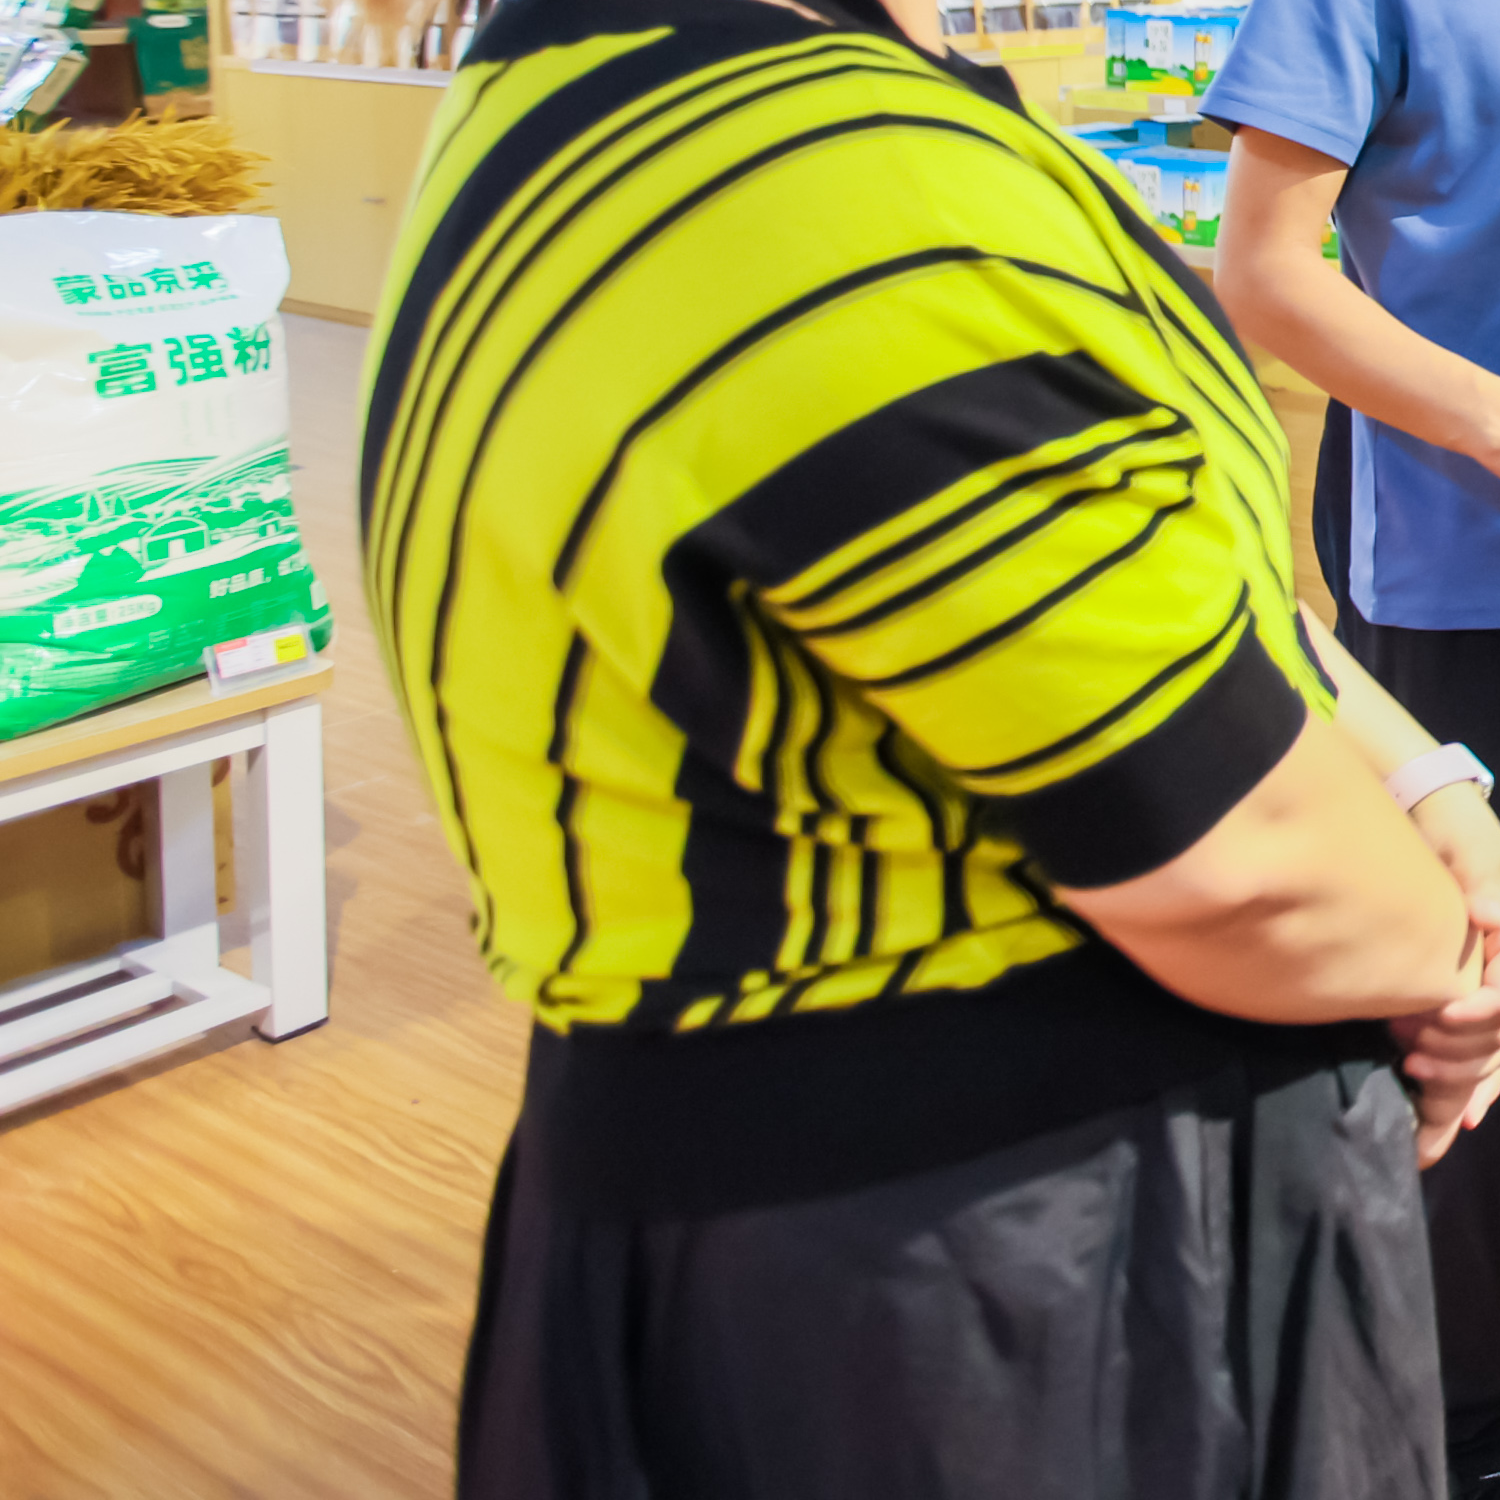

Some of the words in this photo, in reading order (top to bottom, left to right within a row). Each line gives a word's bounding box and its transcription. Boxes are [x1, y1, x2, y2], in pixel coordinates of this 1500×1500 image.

[53, 260, 228, 306] 蒙品京采
[88, 322, 272, 399] 富强粉
